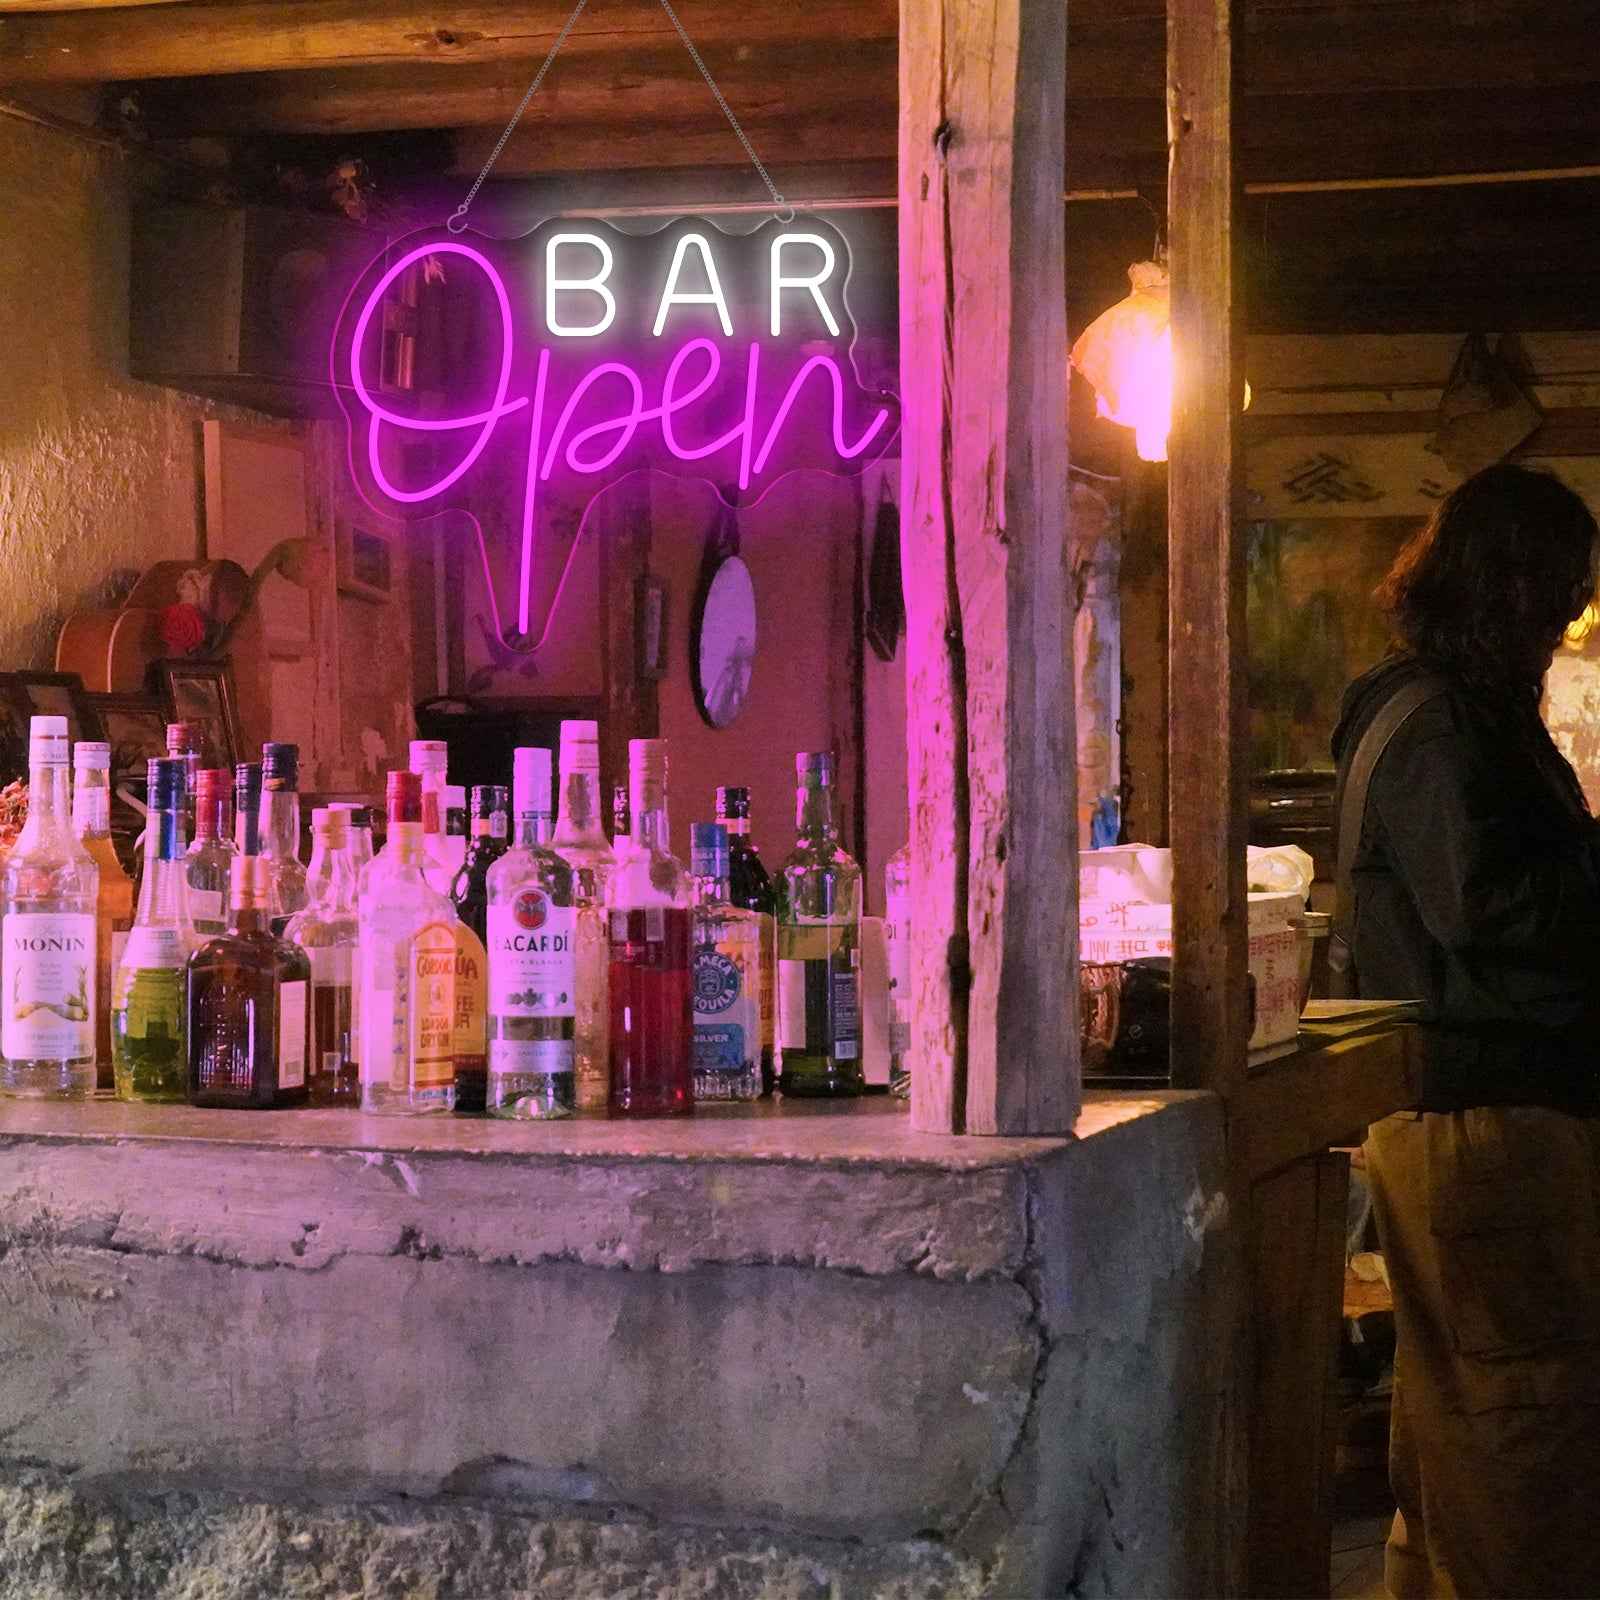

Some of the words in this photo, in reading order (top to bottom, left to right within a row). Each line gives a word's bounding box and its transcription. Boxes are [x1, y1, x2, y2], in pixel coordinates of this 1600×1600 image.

[544, 233, 841, 337] BAR
[350, 241, 889, 636] Open
[15, 937, 86, 952] MONIN
[495, 931, 569, 952] ACARDÍ
[694, 955, 733, 976] MECA
[694, 988, 736, 1011] QUILA
